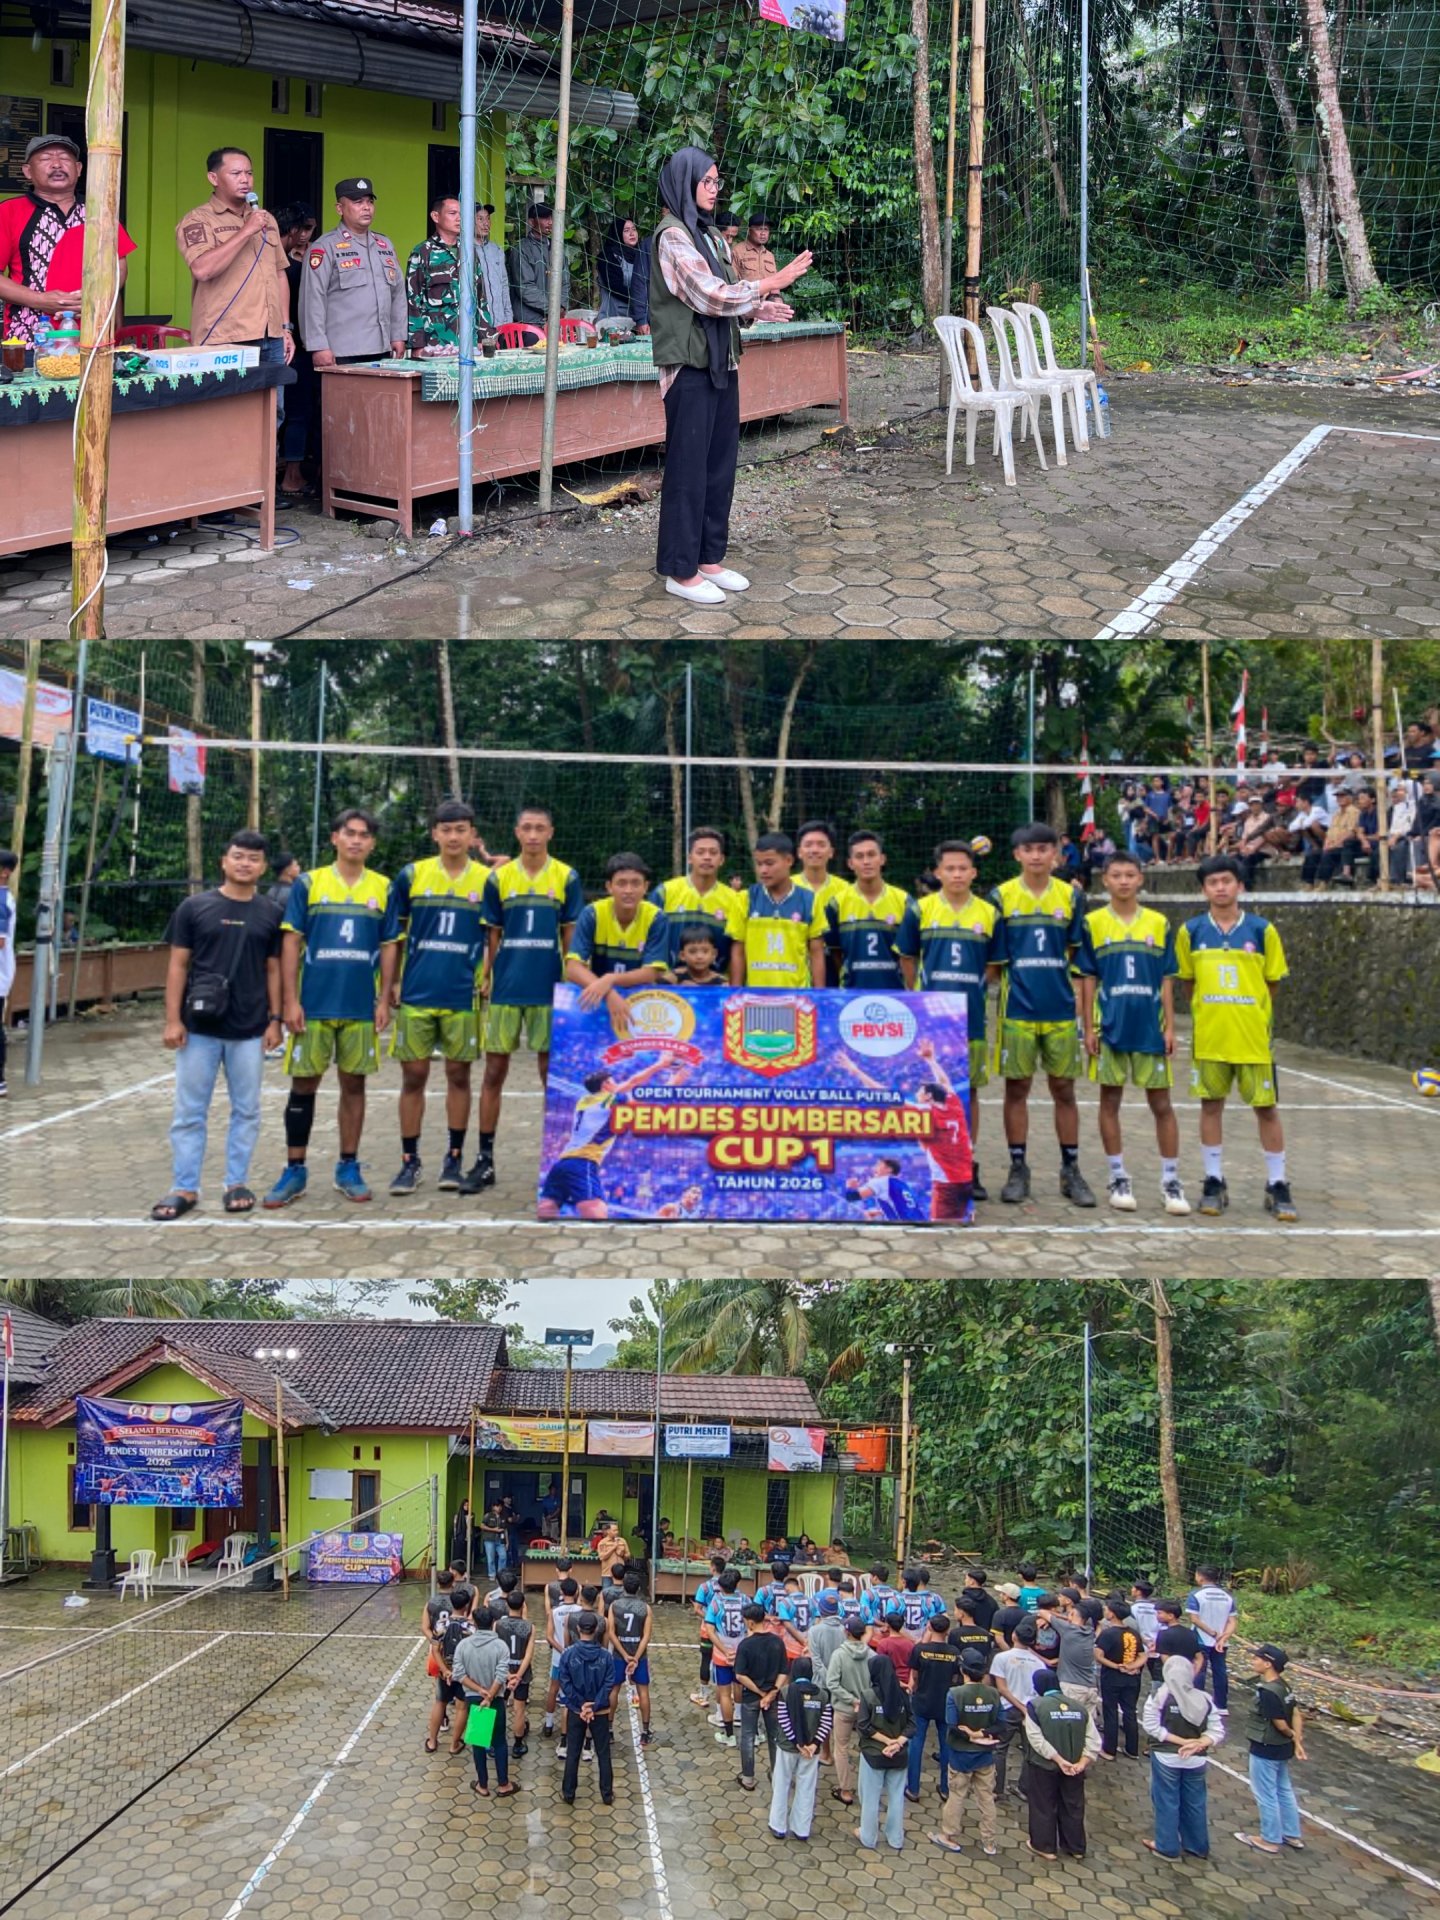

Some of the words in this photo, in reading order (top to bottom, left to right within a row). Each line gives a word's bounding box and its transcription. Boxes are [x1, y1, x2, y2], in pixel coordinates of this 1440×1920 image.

[214, 354, 238, 365] SiDU
[340, 919, 354, 943] 4
[438, 911, 455, 936] 11
[526, 909, 534, 933] 1
[866, 932, 878, 956] 2
[1034, 928, 1045, 952] 7
[951, 942, 961, 966] 5
[1125, 955, 1135, 979] 6
[852, 1023, 903, 1038] PBVSI
[634, 1087, 673, 1099] OPEN
[675, 1087, 771, 1099] TOURNAMENT
[774, 1088, 815, 1100] VOLLY
[818, 1090, 853, 1100] BALL
[856, 1091, 901, 1102] PUTRA
[615, 1106, 735, 1132] PEMDES
[741, 1107, 931, 1135] SUMBERSARI
[714, 1136, 805, 1166] CUP
[810, 1138, 831, 1166] 1
[716, 1175, 775, 1189] TAHUN
[779, 1177, 823, 1190] 2026
[119, 1426, 154, 1435] SELAMAT
[156, 1426, 202, 1436] BERTANDING
[668, 1425, 693, 1435] PUTRI
[695, 1426, 728, 1436] MENTER
[104, 1446, 137, 1456] PEMDES
[139, 1447, 191, 1457] SUMBERSARI
[193, 1448, 209, 1457] CUP
[146, 1457, 172, 1466] 2026
[623, 1612, 634, 1632] 7
[725, 1610, 742, 1632] 13
[905, 1605, 922, 1625] 12
[510, 1634, 517, 1654] 1
